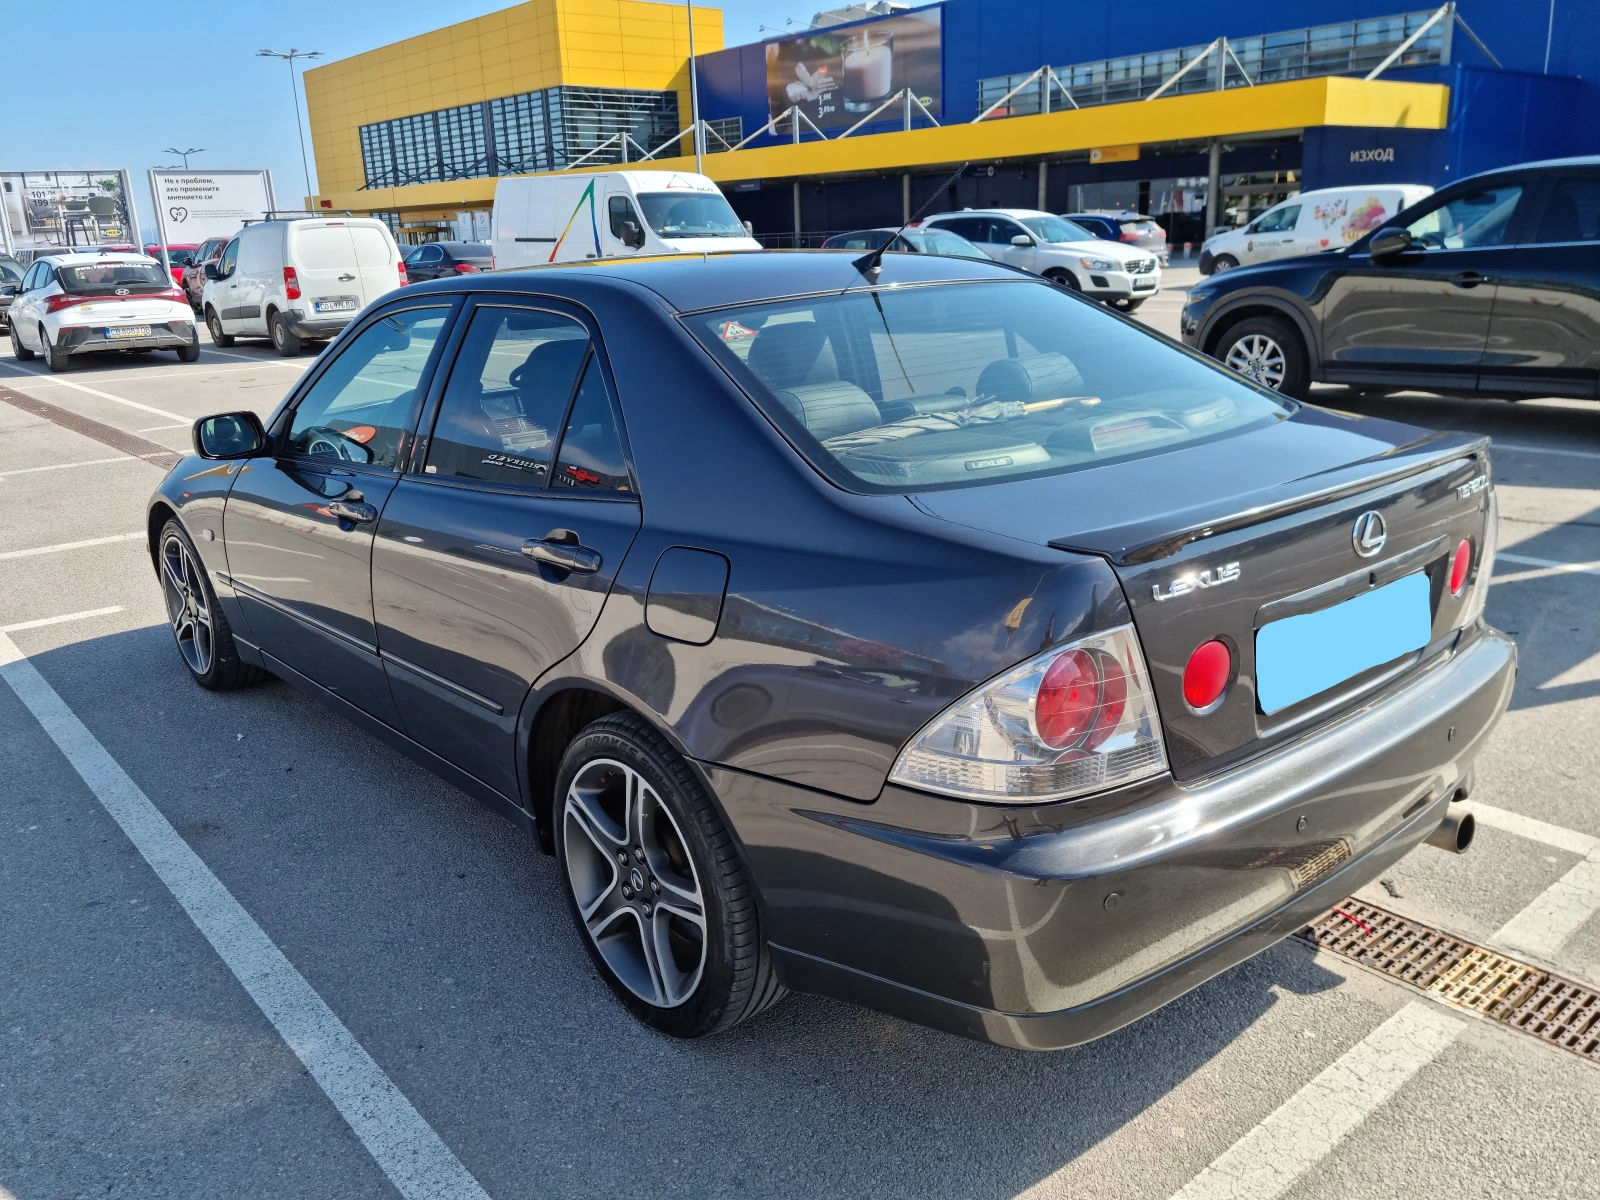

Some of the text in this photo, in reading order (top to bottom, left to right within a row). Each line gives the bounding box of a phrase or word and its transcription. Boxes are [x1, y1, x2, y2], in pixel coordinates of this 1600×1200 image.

[1350, 147, 1395, 163] ИЗХОД
[181, 177, 215, 185] проблем,
[180, 186, 220, 194] промените
[1254, 240, 1282, 248] UNIGEL
[971, 458, 1007, 469] LEXUS
[1151, 561, 1241, 602] LEXUS
[584, 735, 639, 755] PROXES
